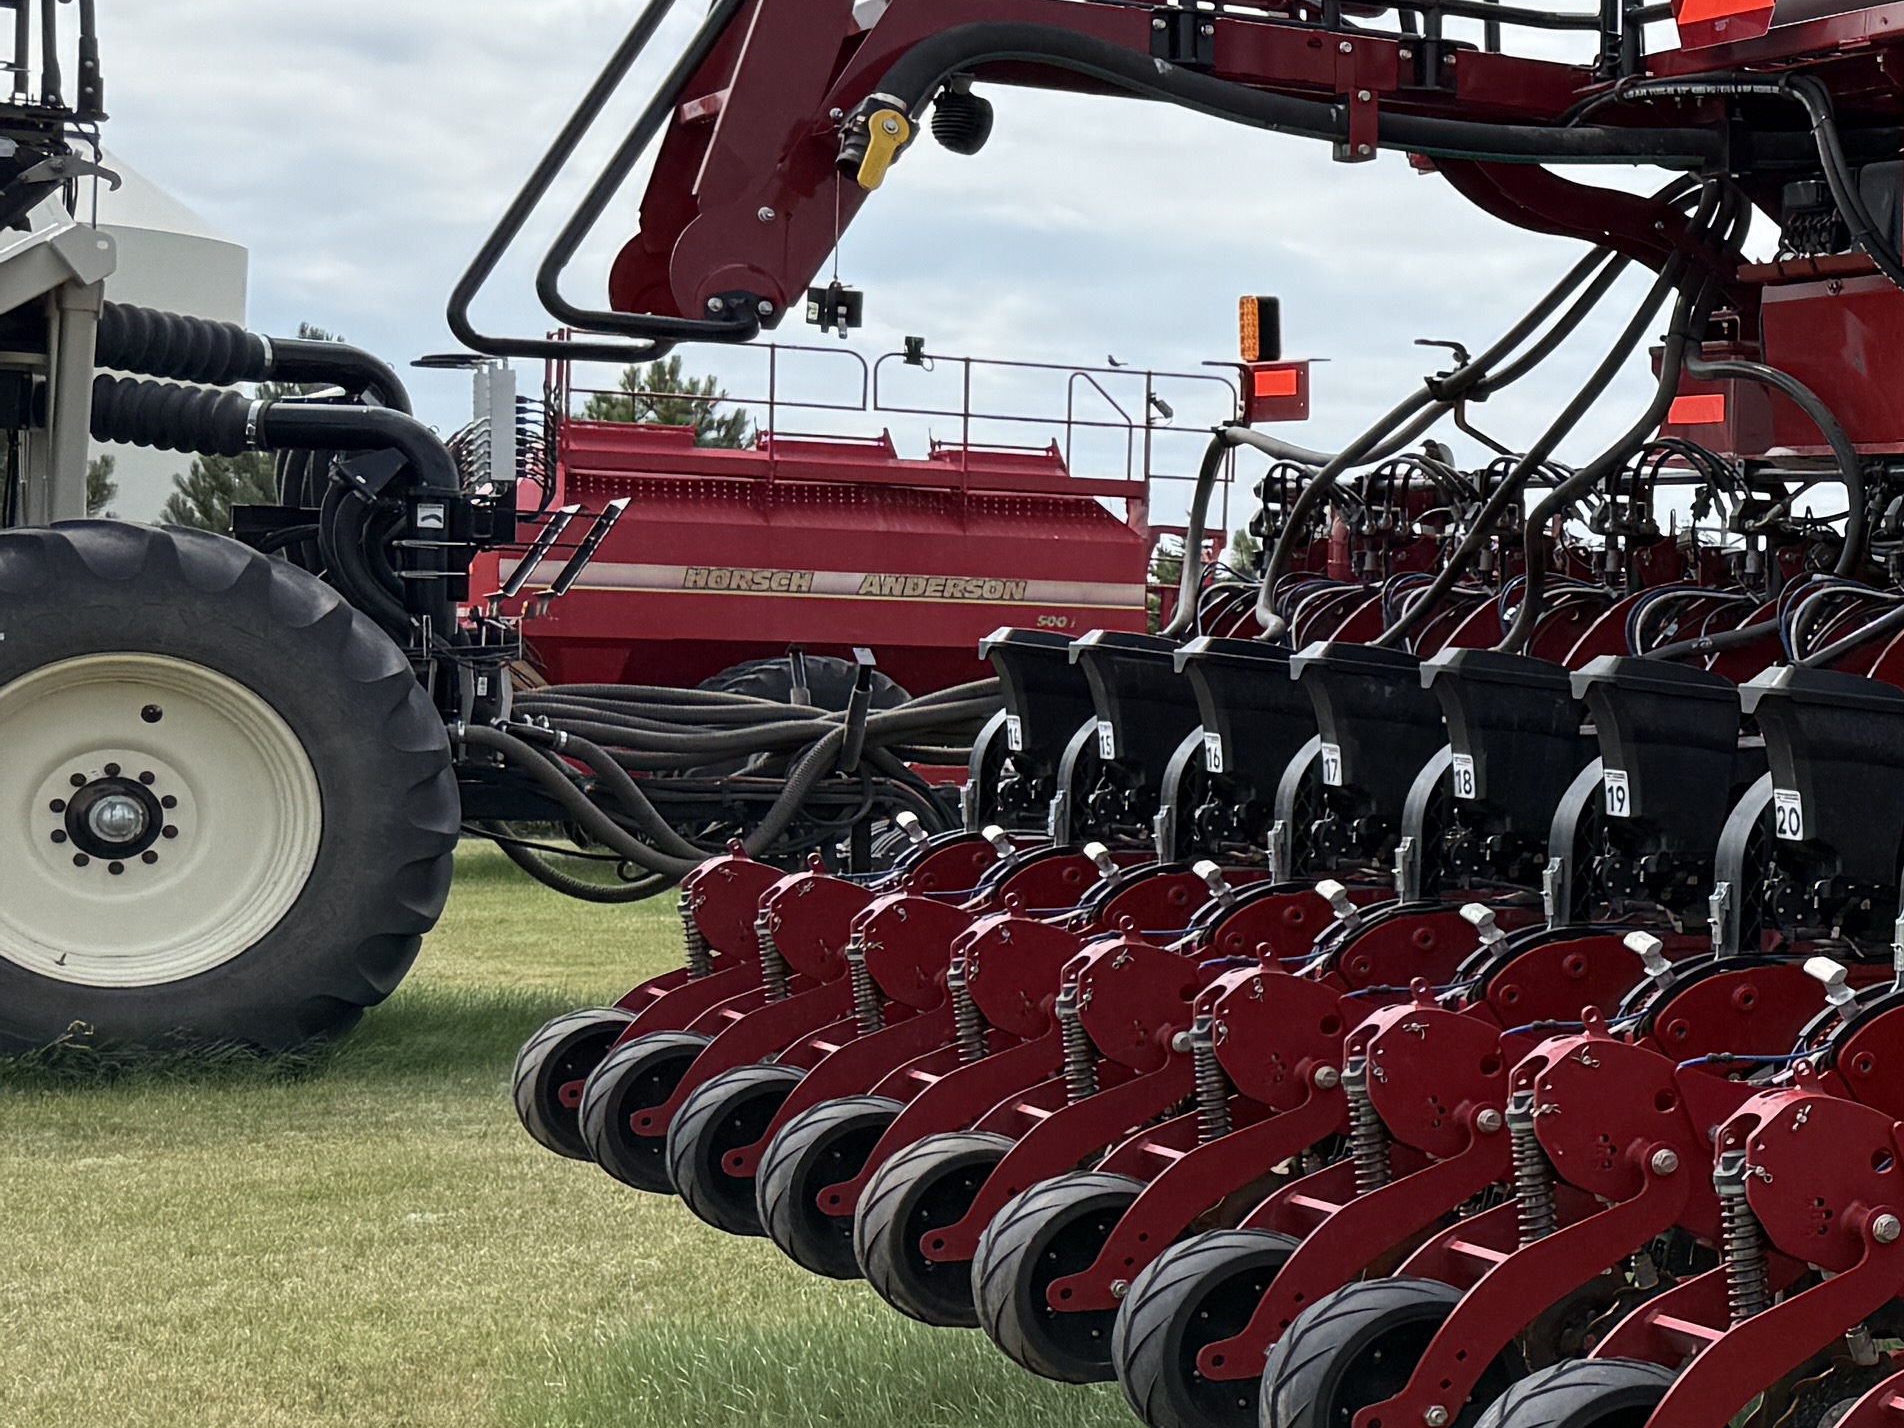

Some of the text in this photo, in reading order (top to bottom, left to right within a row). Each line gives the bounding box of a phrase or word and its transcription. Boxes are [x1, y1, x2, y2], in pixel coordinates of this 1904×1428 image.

[684, 568, 1027, 600] HORSCH ANDERSON
[1036, 615, 1068, 628] 500
[1009, 727, 1020, 749] 14
[1101, 735, 1113, 756] 15
[1207, 746, 1221, 769] 16
[1325, 758, 1338, 782] 17
[1455, 769, 1472, 796] 18
[1608, 785, 1626, 813] 19
[1777, 805, 1800, 836] 20
